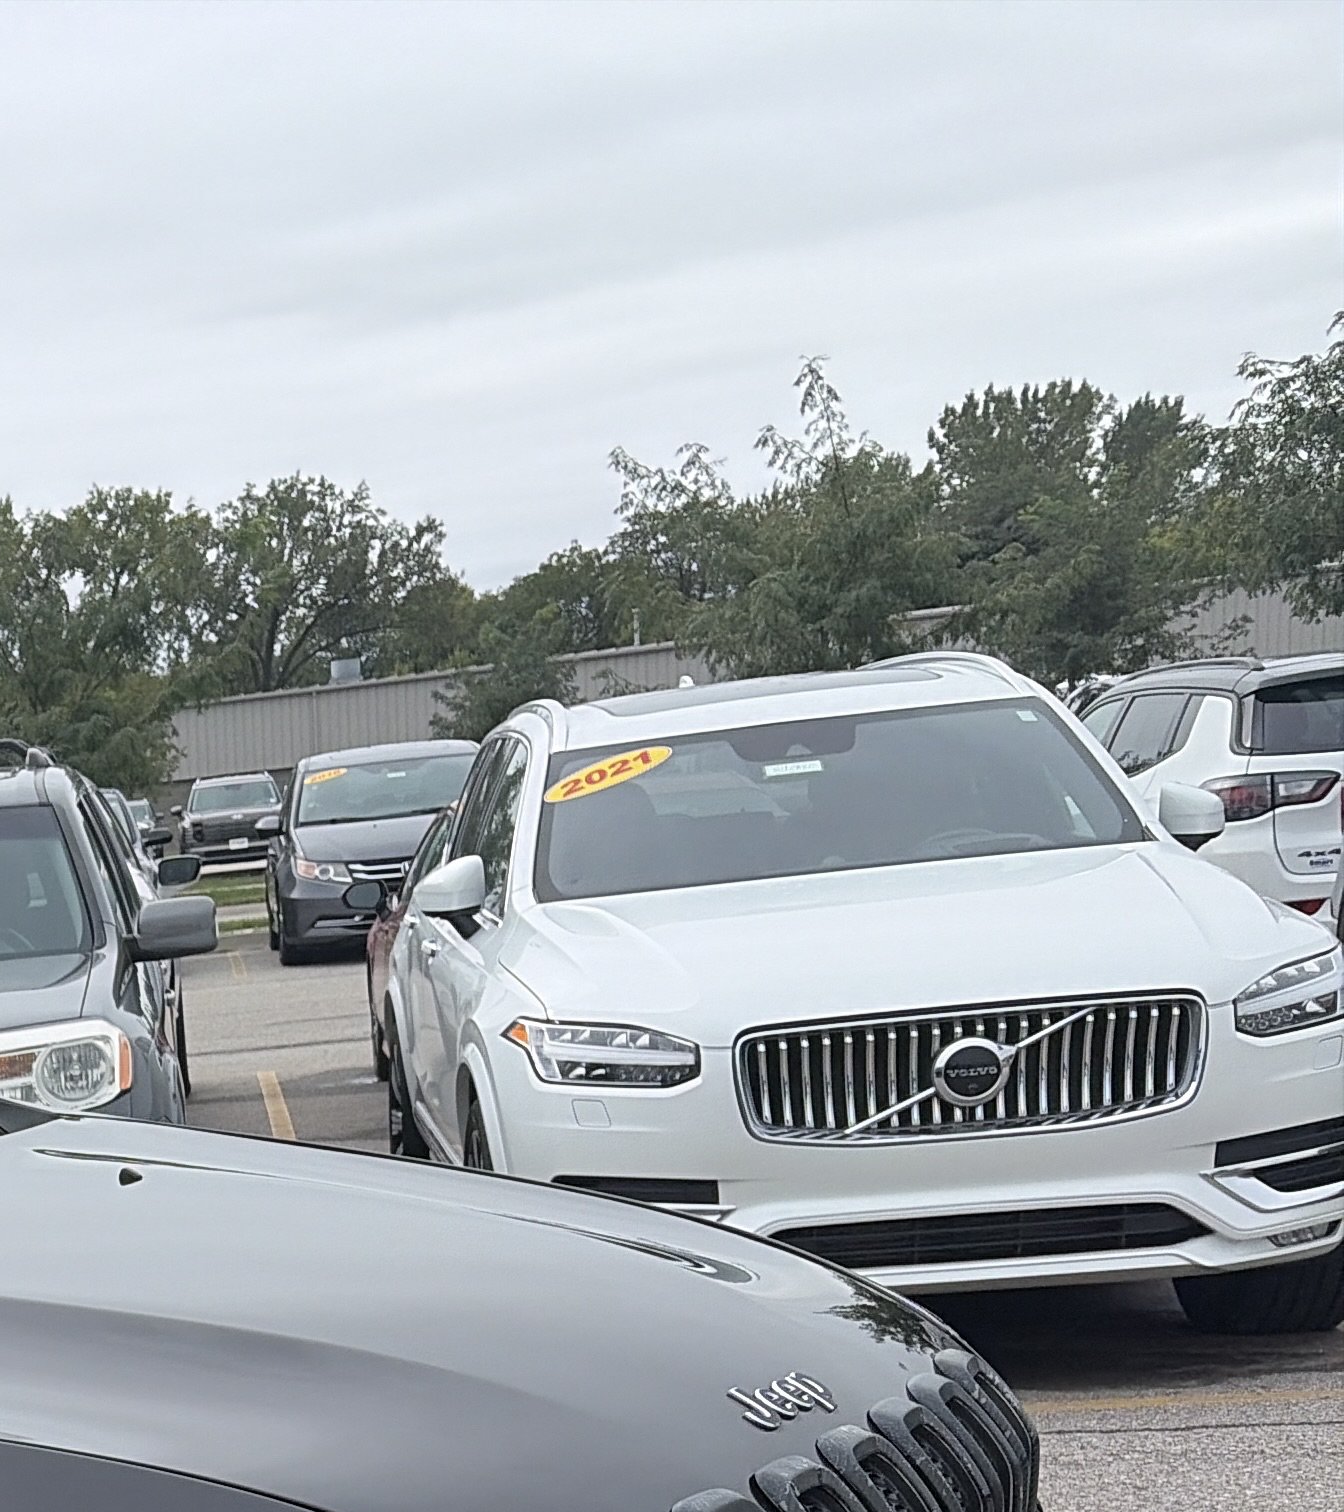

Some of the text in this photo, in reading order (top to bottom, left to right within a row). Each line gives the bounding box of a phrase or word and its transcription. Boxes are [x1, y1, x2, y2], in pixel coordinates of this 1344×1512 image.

[560, 750, 653, 798] 2021
[946, 1066, 998, 1078] VOLVO
[726, 1371, 838, 1432] Jeep
